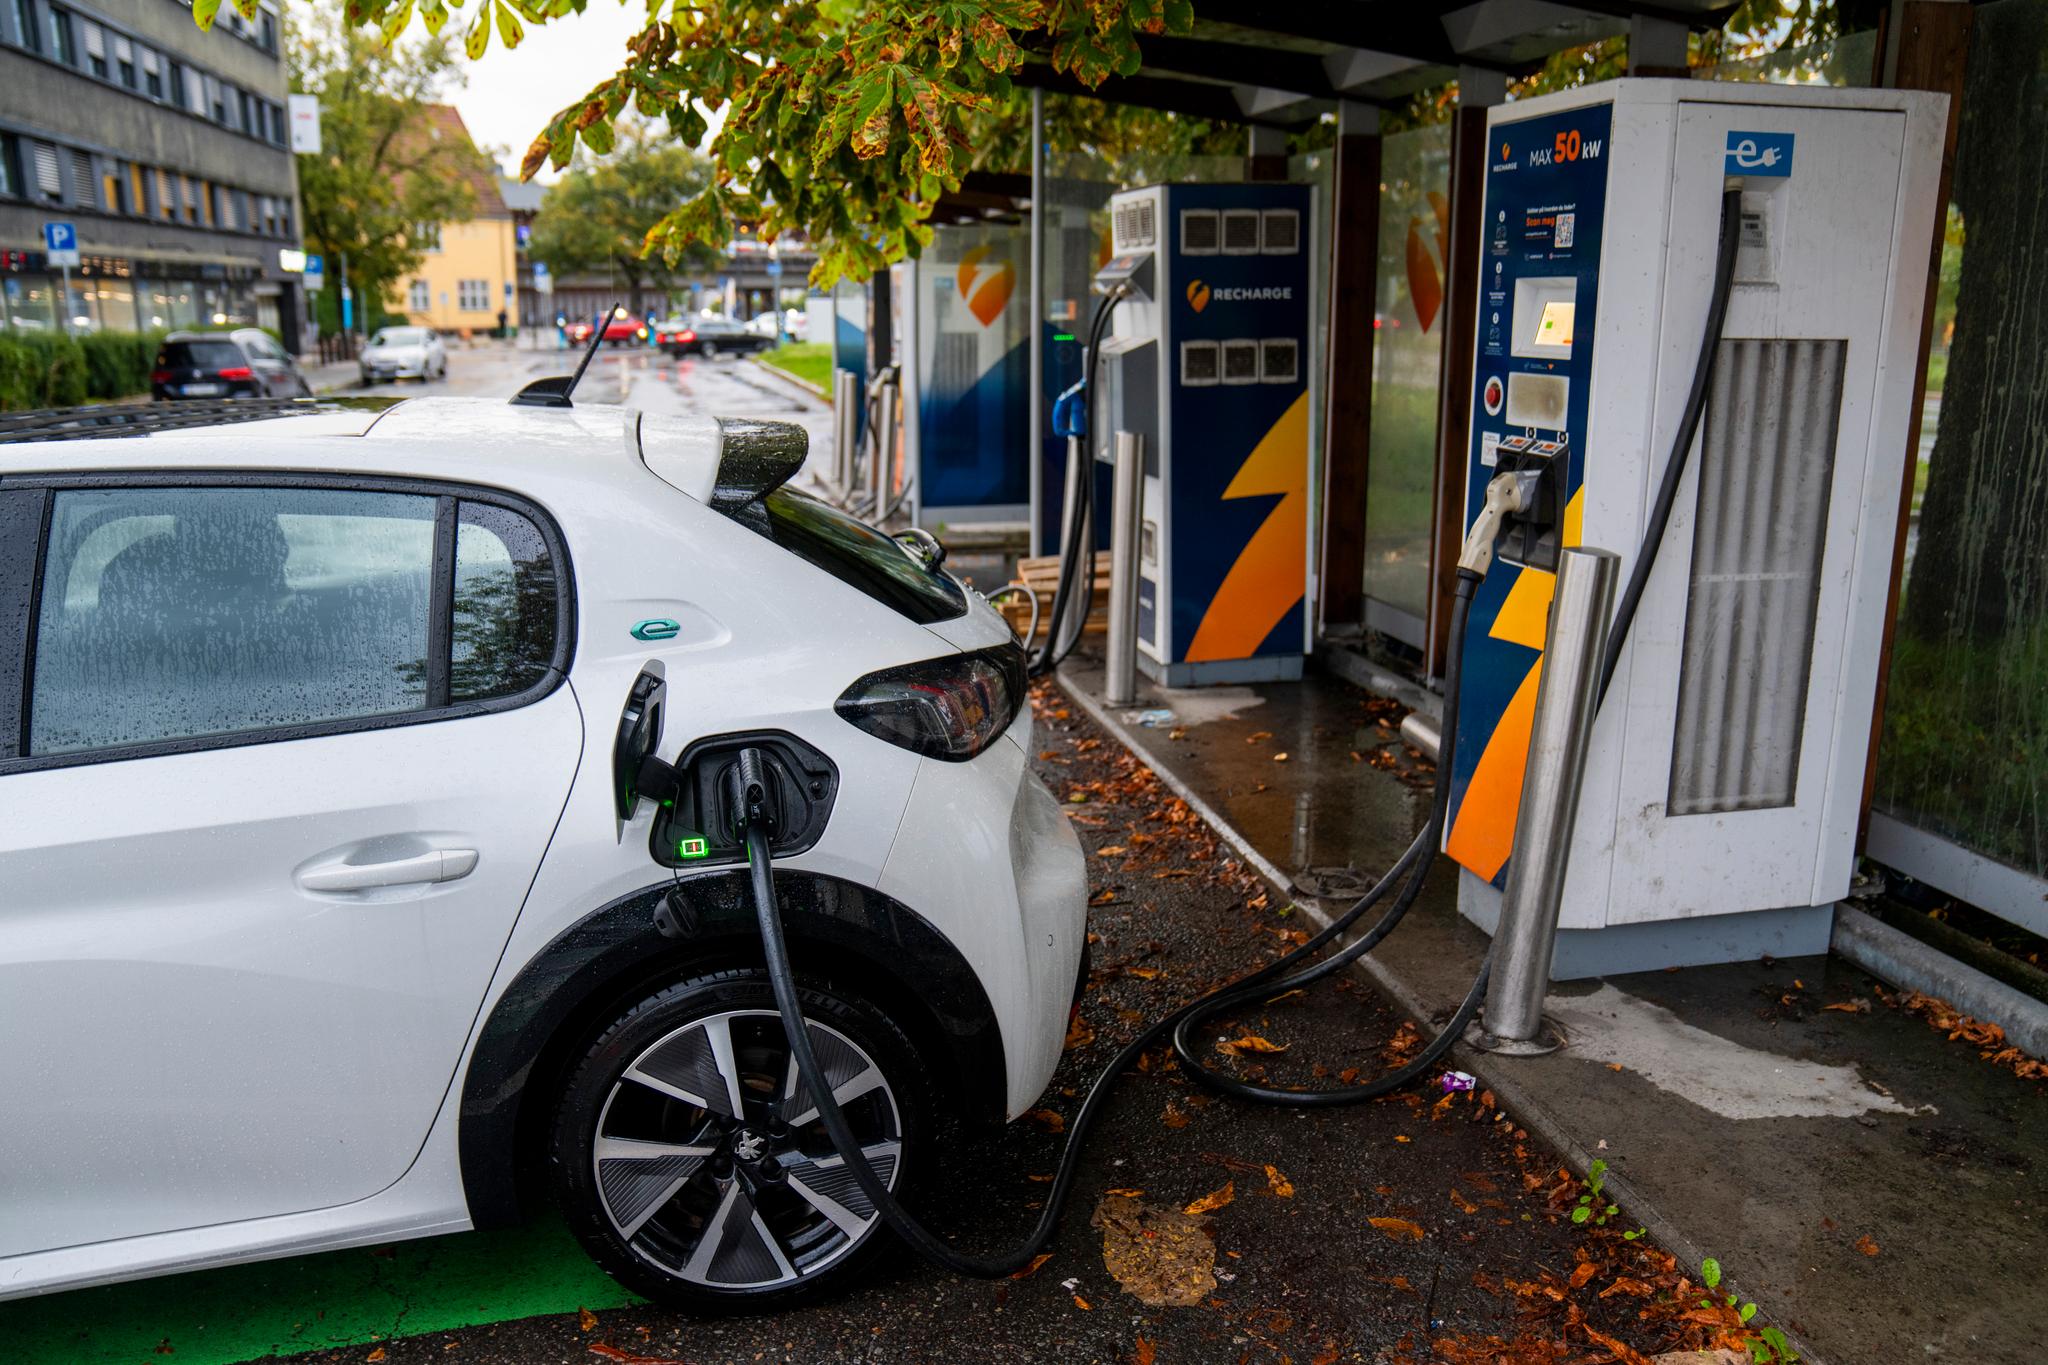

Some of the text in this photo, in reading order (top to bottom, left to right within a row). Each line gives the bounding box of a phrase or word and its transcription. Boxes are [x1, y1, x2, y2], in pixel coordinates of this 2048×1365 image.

[1529, 129, 1602, 167] MAX 50 kW
[1493, 162, 1518, 172] RECHARGE
[52, 224, 69, 249] P
[1213, 286, 1293, 301] RECHARGE
